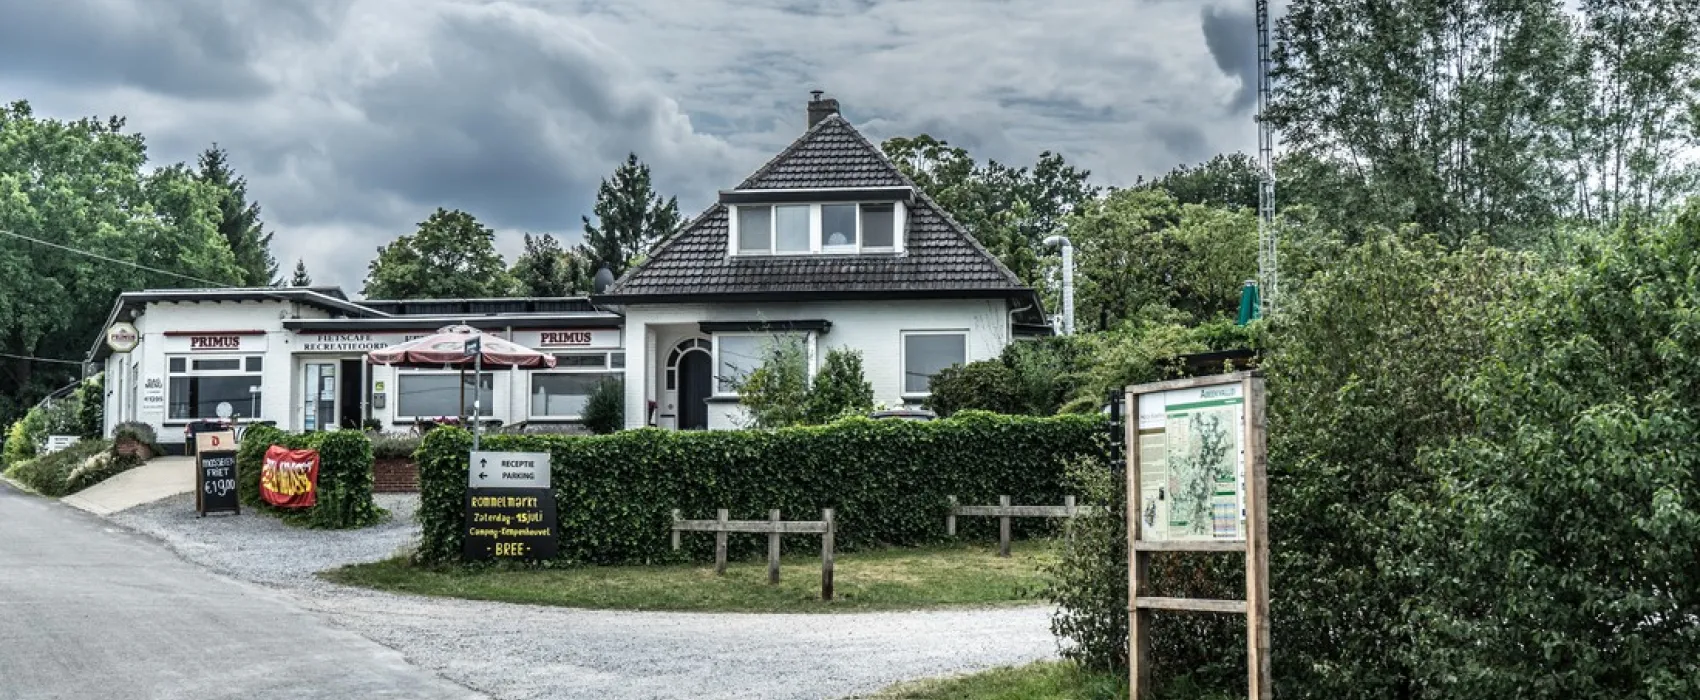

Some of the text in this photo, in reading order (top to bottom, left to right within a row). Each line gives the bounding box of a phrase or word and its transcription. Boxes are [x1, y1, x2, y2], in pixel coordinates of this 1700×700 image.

[190, 336, 239, 347] PRIMUS
[541, 332, 591, 343] PRIMUS
[501, 460, 535, 468] RECEPTIE
[206, 467, 229, 477] FRIET
[502, 472, 535, 480] PARKING
[495, 542, 525, 556] BREE
